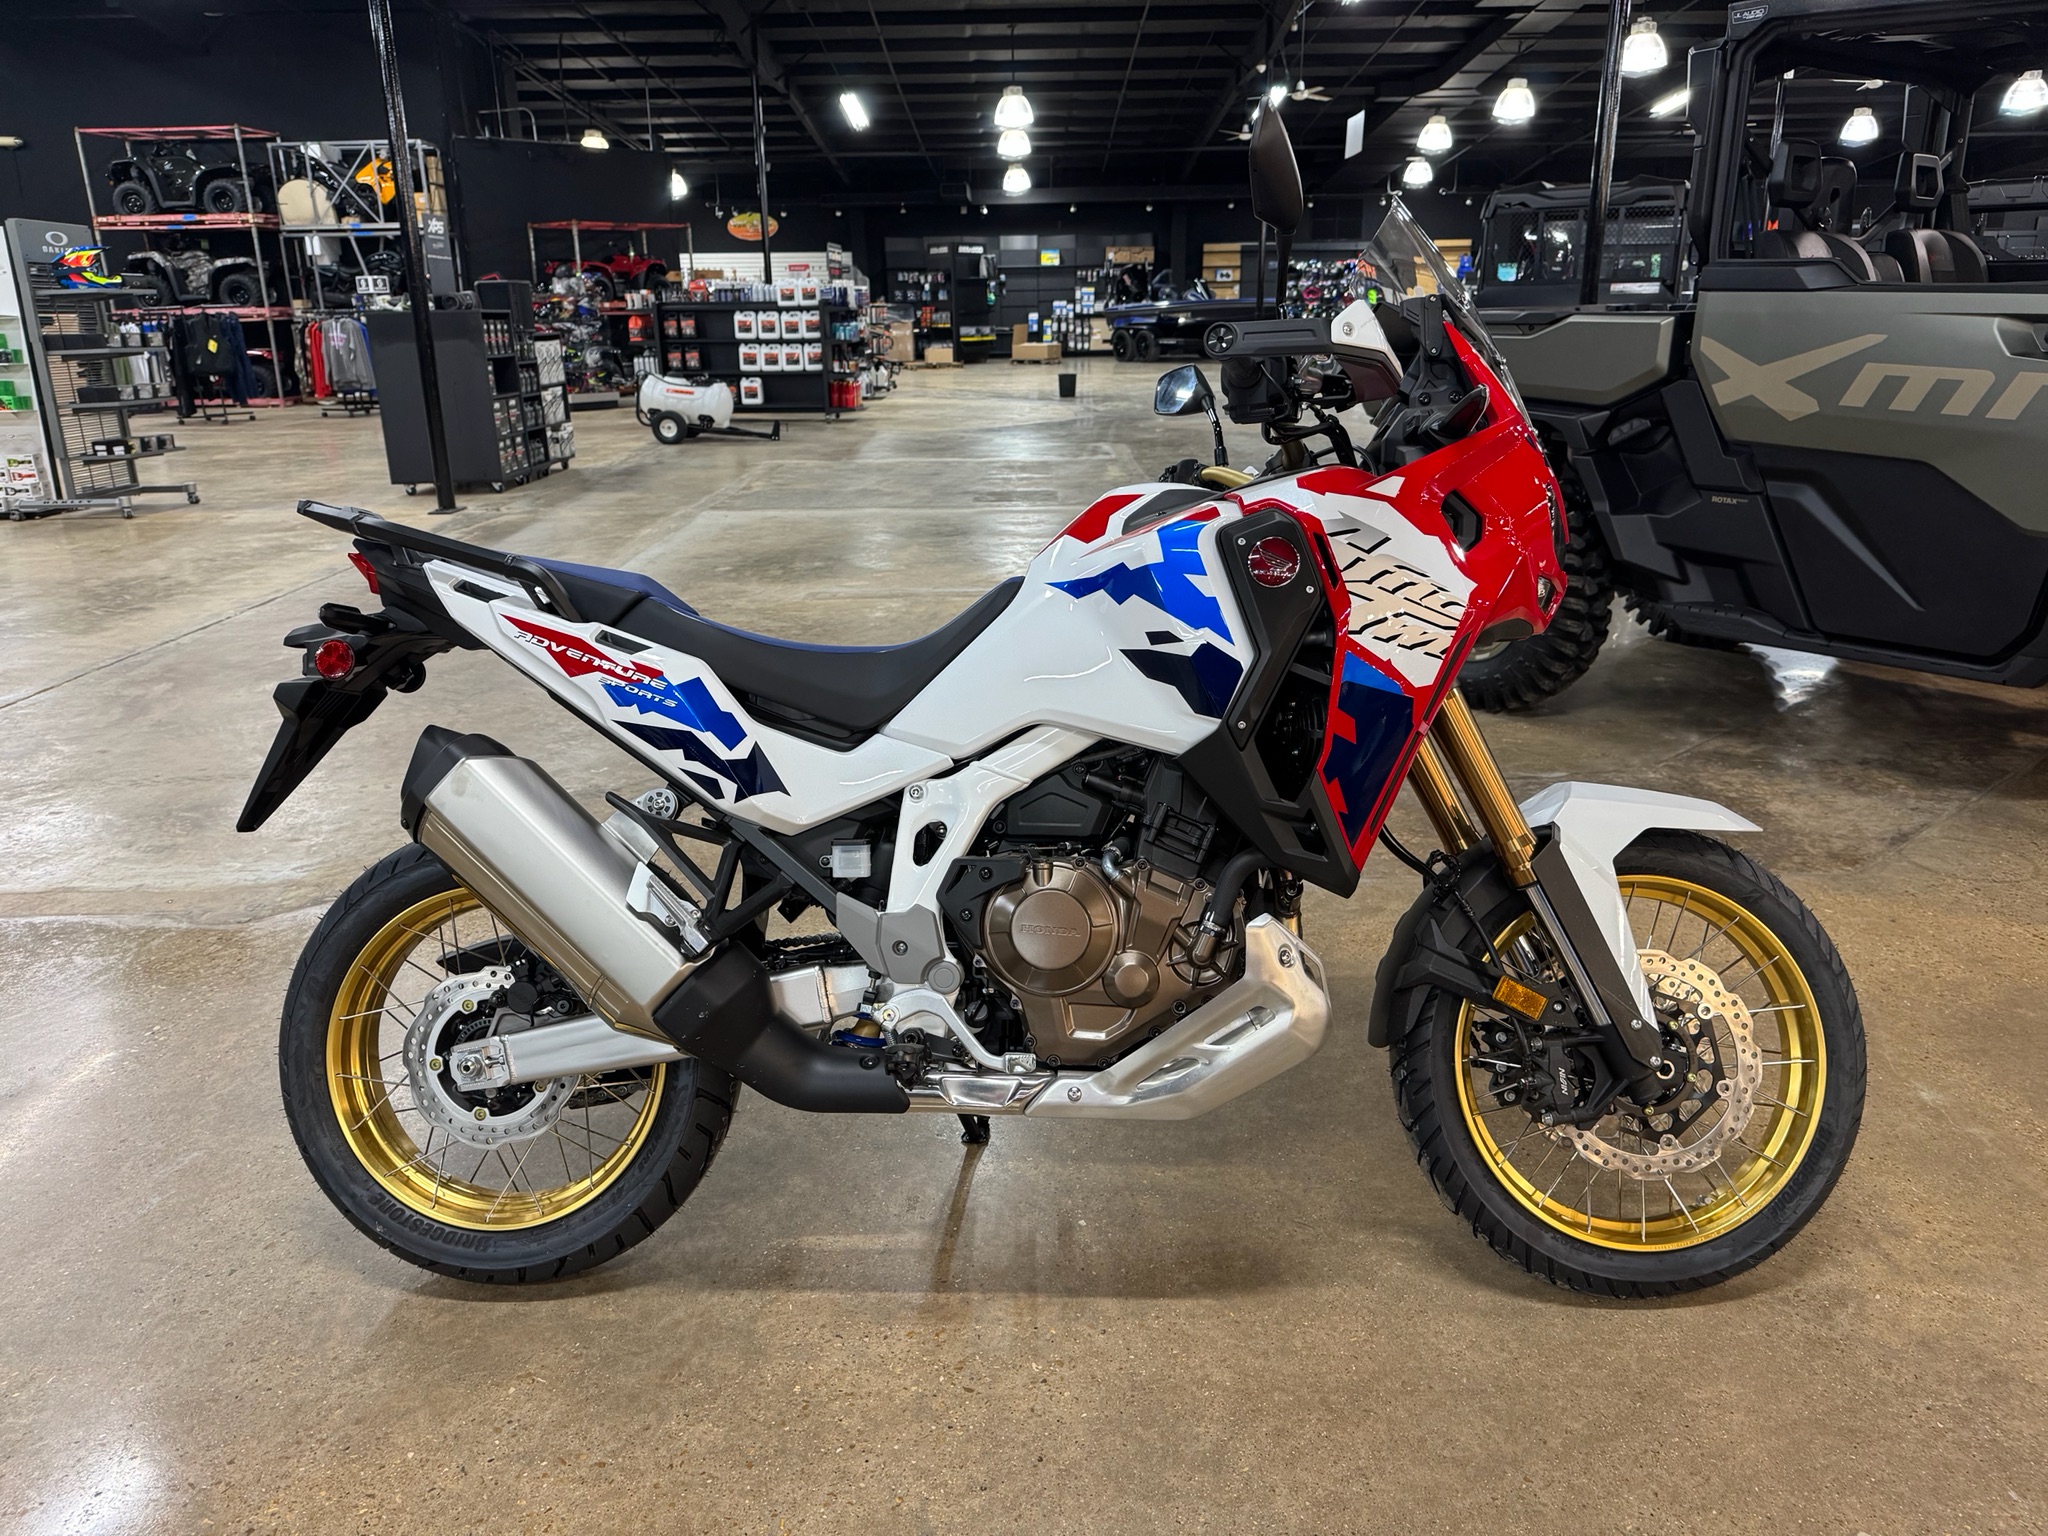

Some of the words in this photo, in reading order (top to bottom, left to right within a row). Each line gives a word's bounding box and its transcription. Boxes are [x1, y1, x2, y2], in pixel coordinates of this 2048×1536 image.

[427, 217, 445, 235] XPS
[1711, 495, 1738, 505] ROTAX
[513, 630, 668, 691] ADVENTURE
[599, 676, 679, 709] SPORTS
[1020, 923, 1082, 938] HONDA
[367, 1191, 494, 1254] BRIDGESTONE
